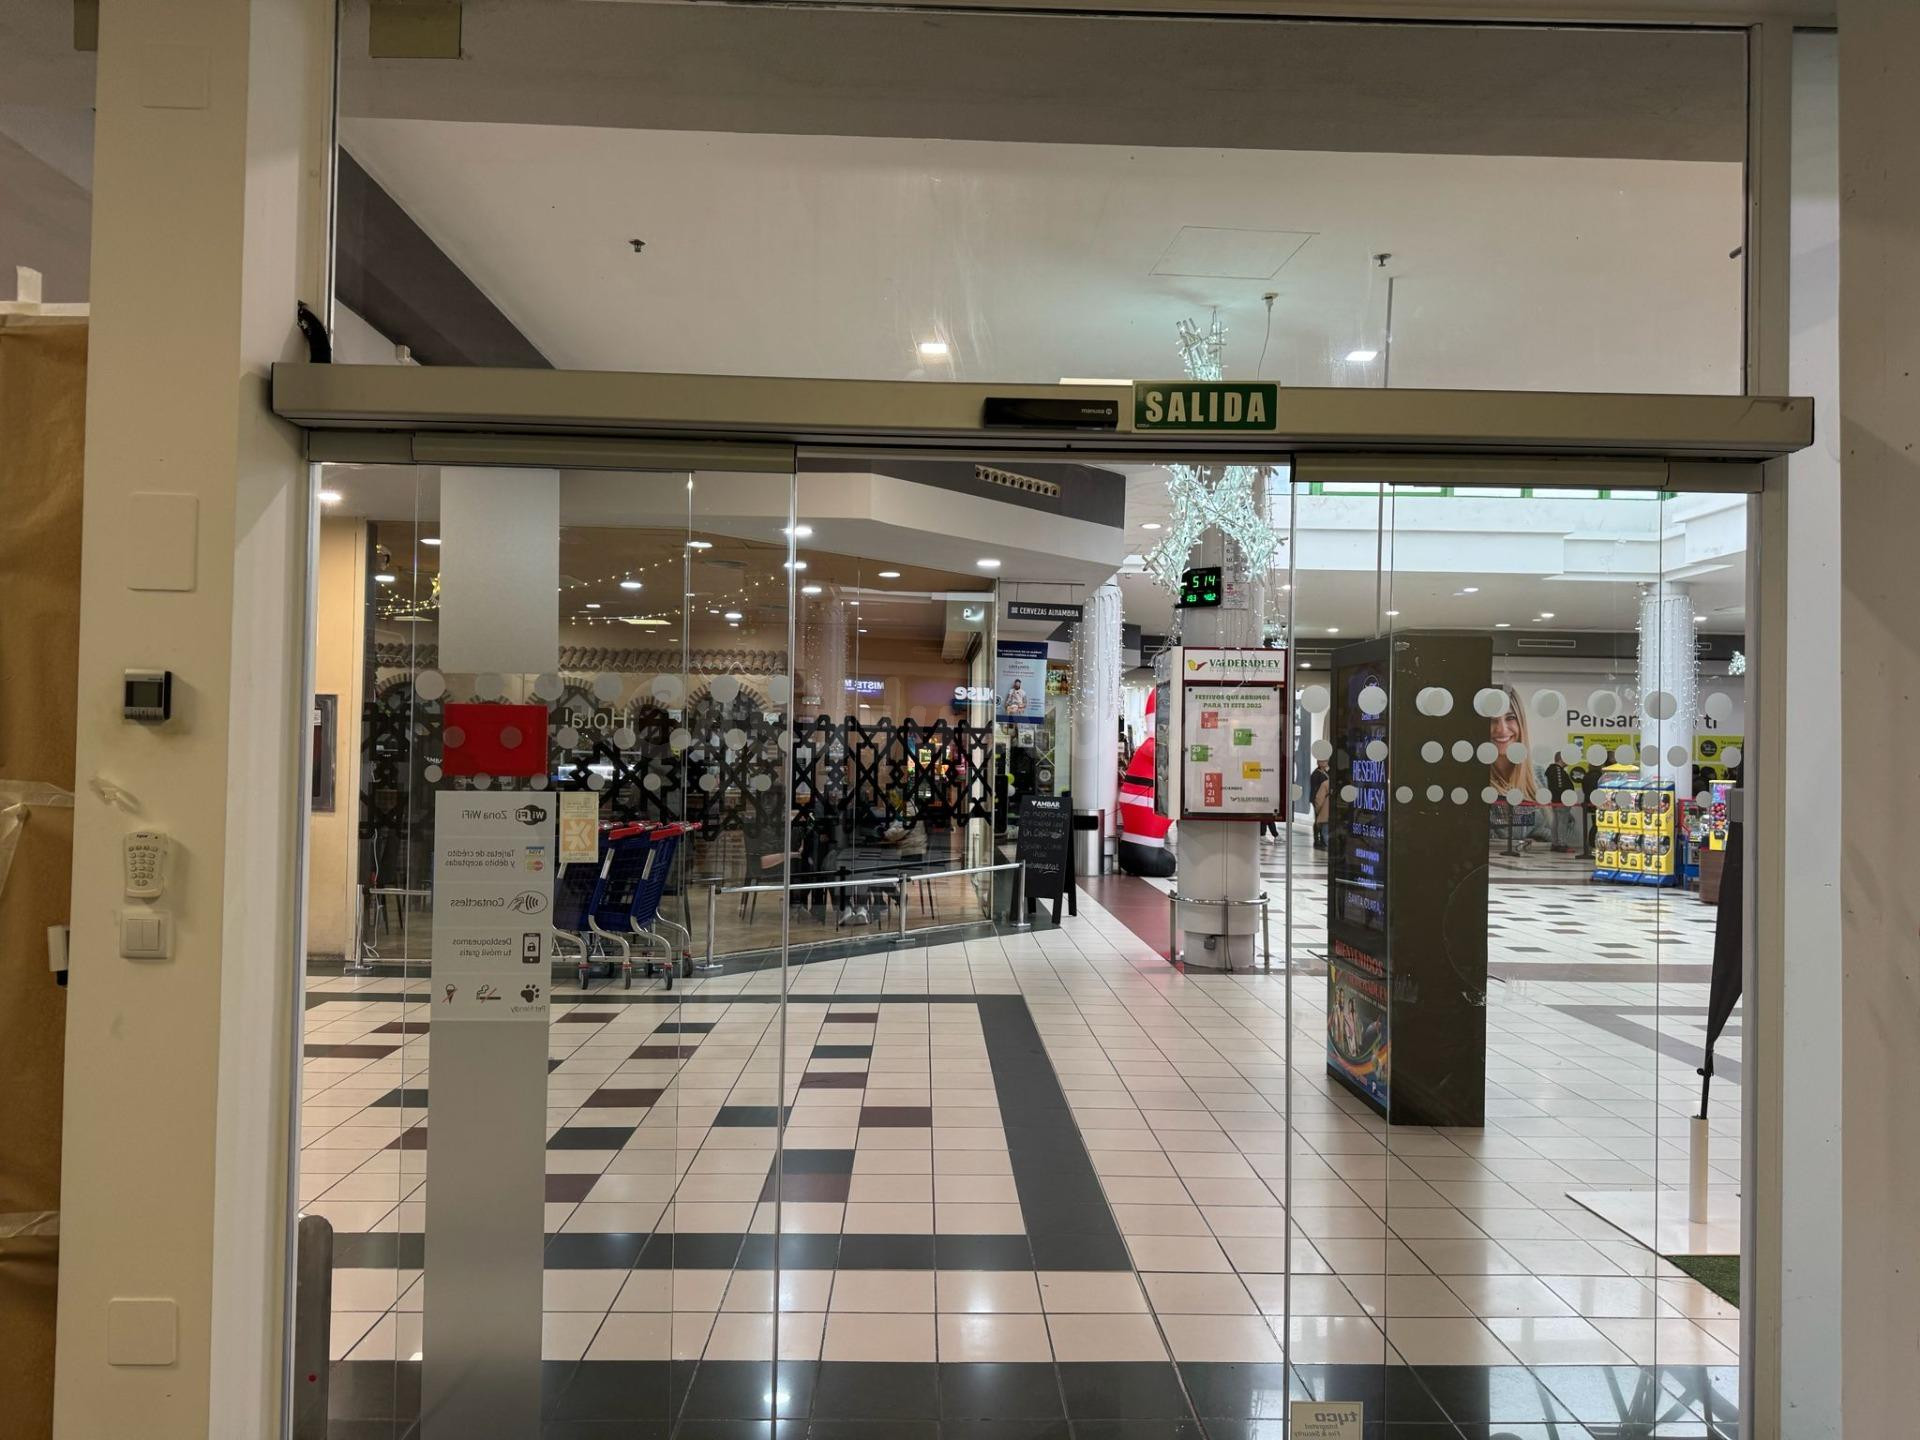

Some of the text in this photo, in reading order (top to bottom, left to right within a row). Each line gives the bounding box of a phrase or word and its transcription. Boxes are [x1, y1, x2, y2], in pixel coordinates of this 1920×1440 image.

[1145, 391, 1266, 423] SALIDA
[1019, 606, 1079, 617] CERVEZAS ALHAMBRA
[1209, 658, 1280, 669] VALDERADUEY
[1226, 694, 1239, 702] QUE
[1352, 760, 1386, 783] RESERVA
[1364, 789, 1386, 812] MESA
